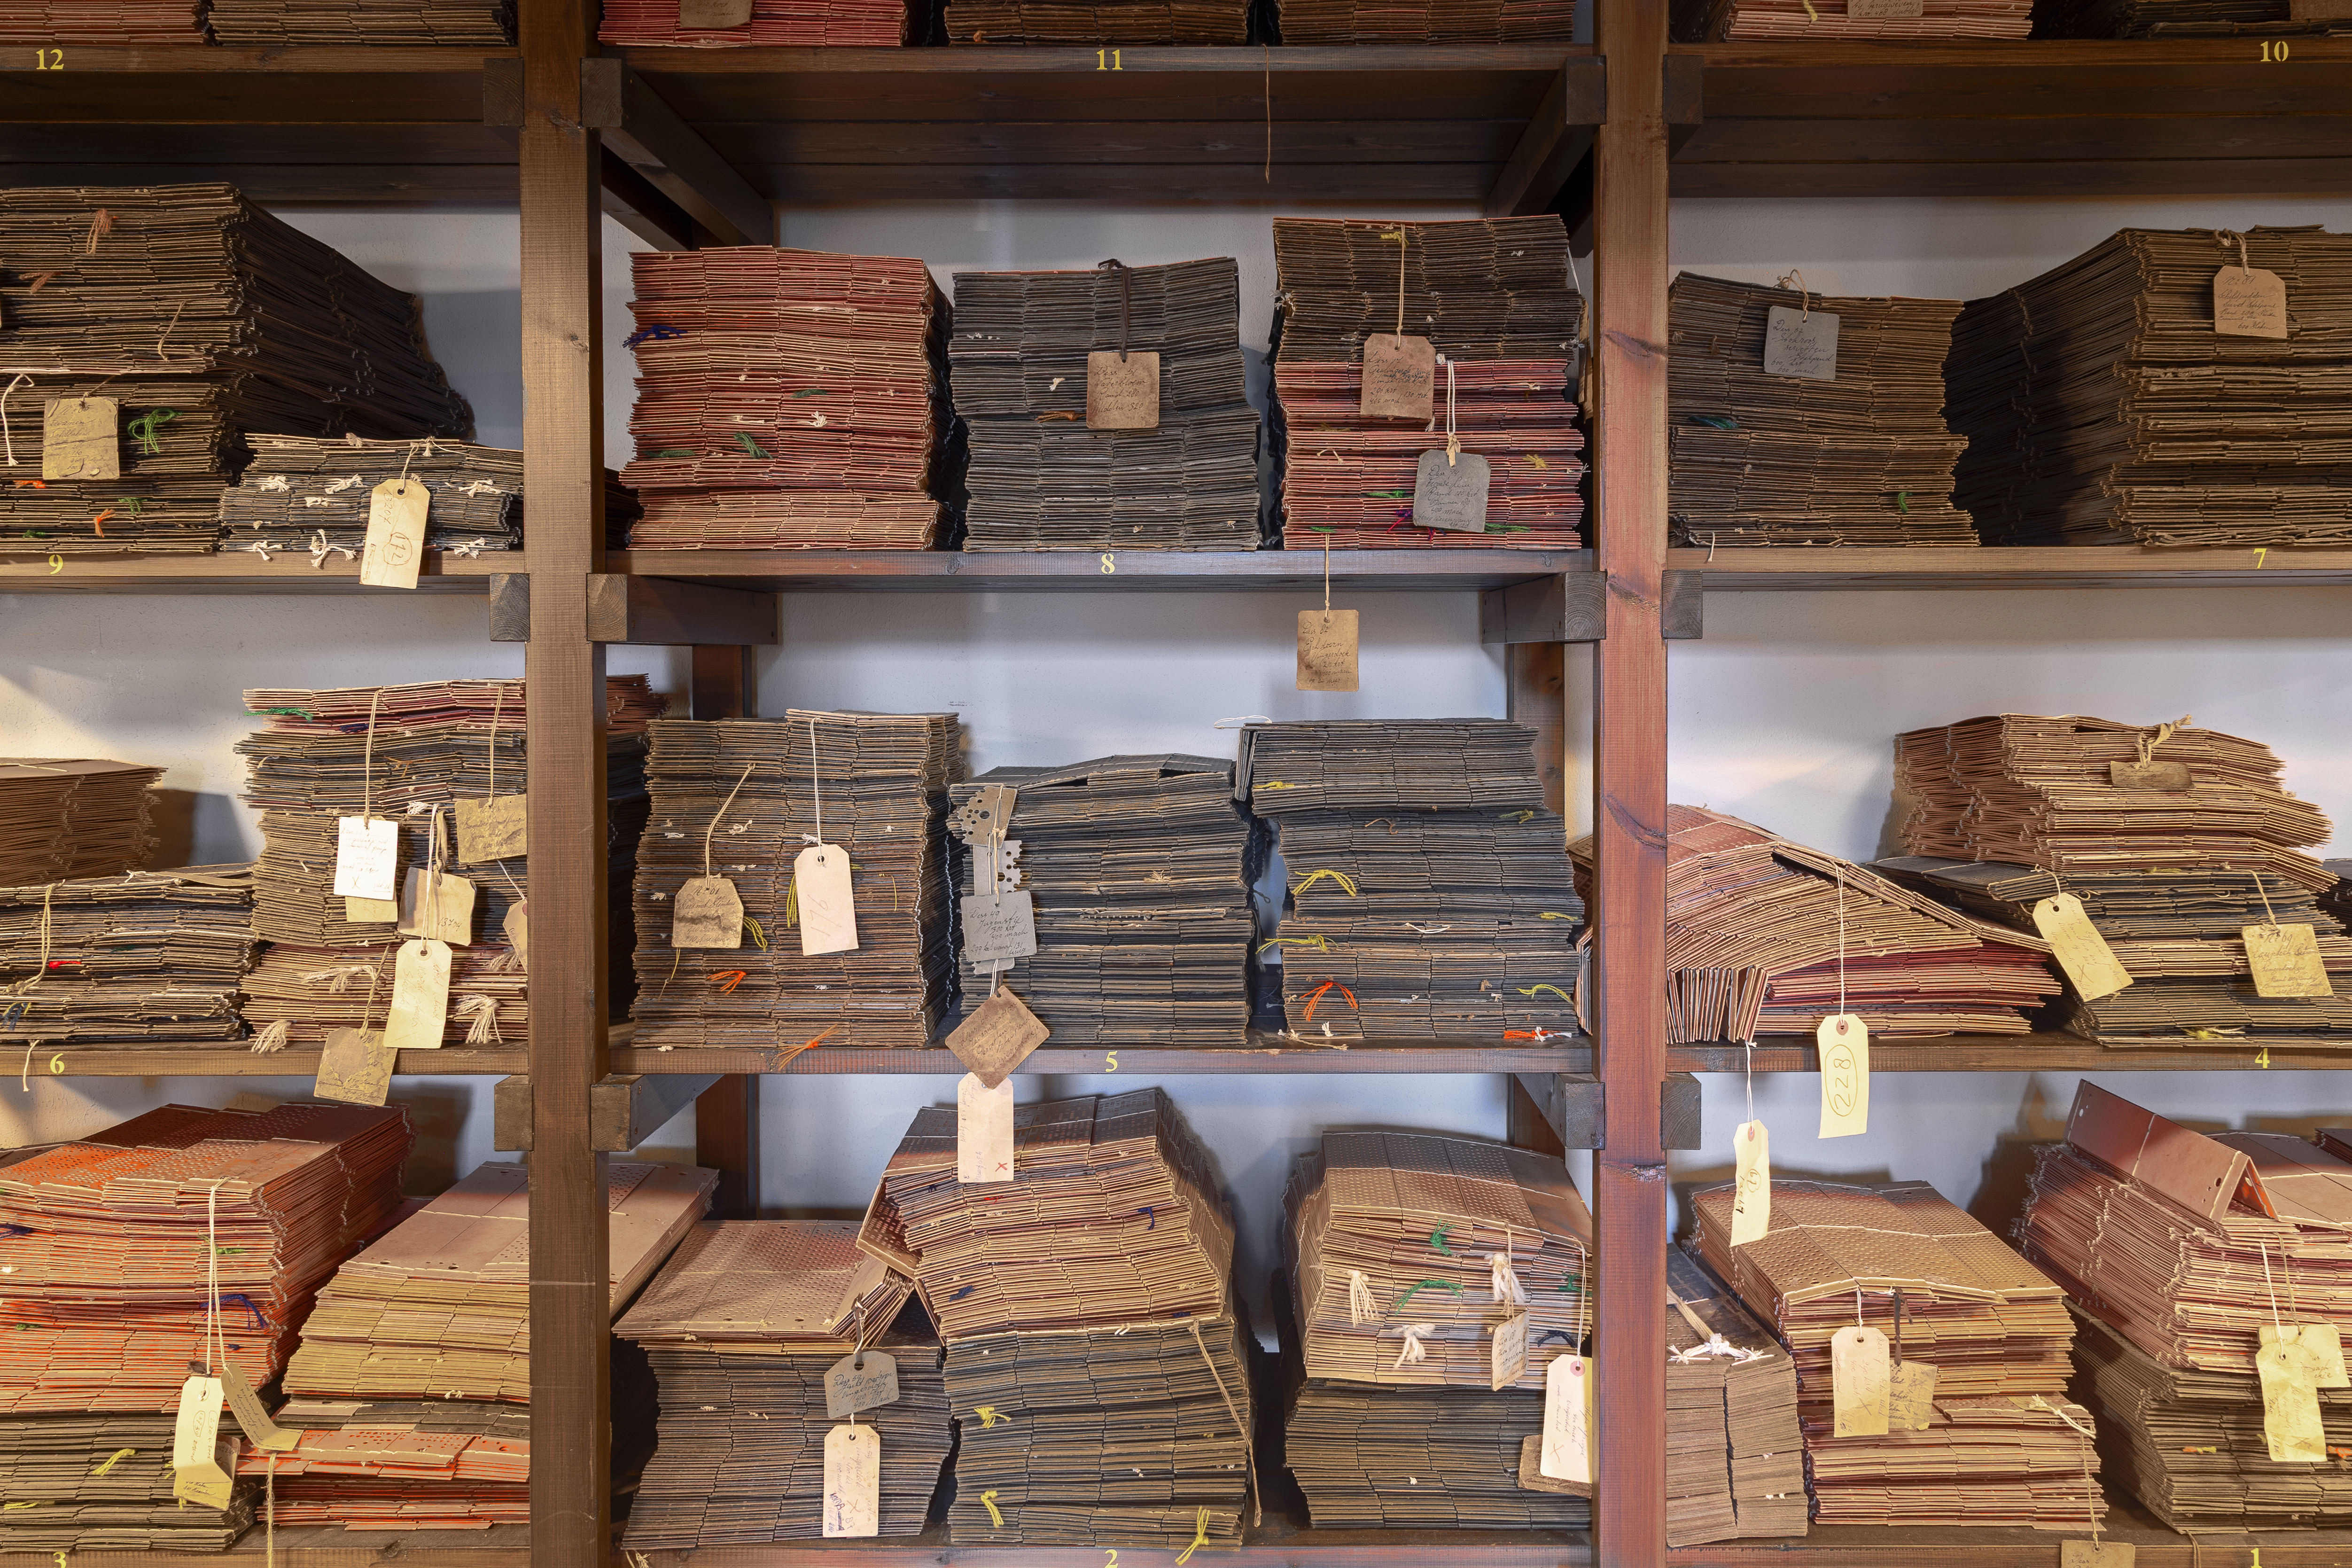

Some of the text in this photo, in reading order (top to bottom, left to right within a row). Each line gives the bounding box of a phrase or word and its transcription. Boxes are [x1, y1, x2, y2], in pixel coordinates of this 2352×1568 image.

[36, 49, 64, 70] 12
[1097, 49, 1122, 70] 11
[2260, 41, 2289, 62] 10
[390, 535, 406, 562] 172
[2253, 548, 2267, 569] 7
[49, 555, 62, 575] 9
[1101, 554, 1114, 574] 8
[807, 894, 842, 936] 176
[2282, 929, 2293, 949] 69
[50, 1053, 65, 1074] 6
[1106, 1051, 1118, 1072] 5
[2254, 1048, 2270, 1069] 4
[1833, 1059, 1851, 1109] 228
[53, 1552, 66, 1568] 3
[1105, 1550, 1118, 1568] 2
[2251, 1548, 2262, 1568] 1
